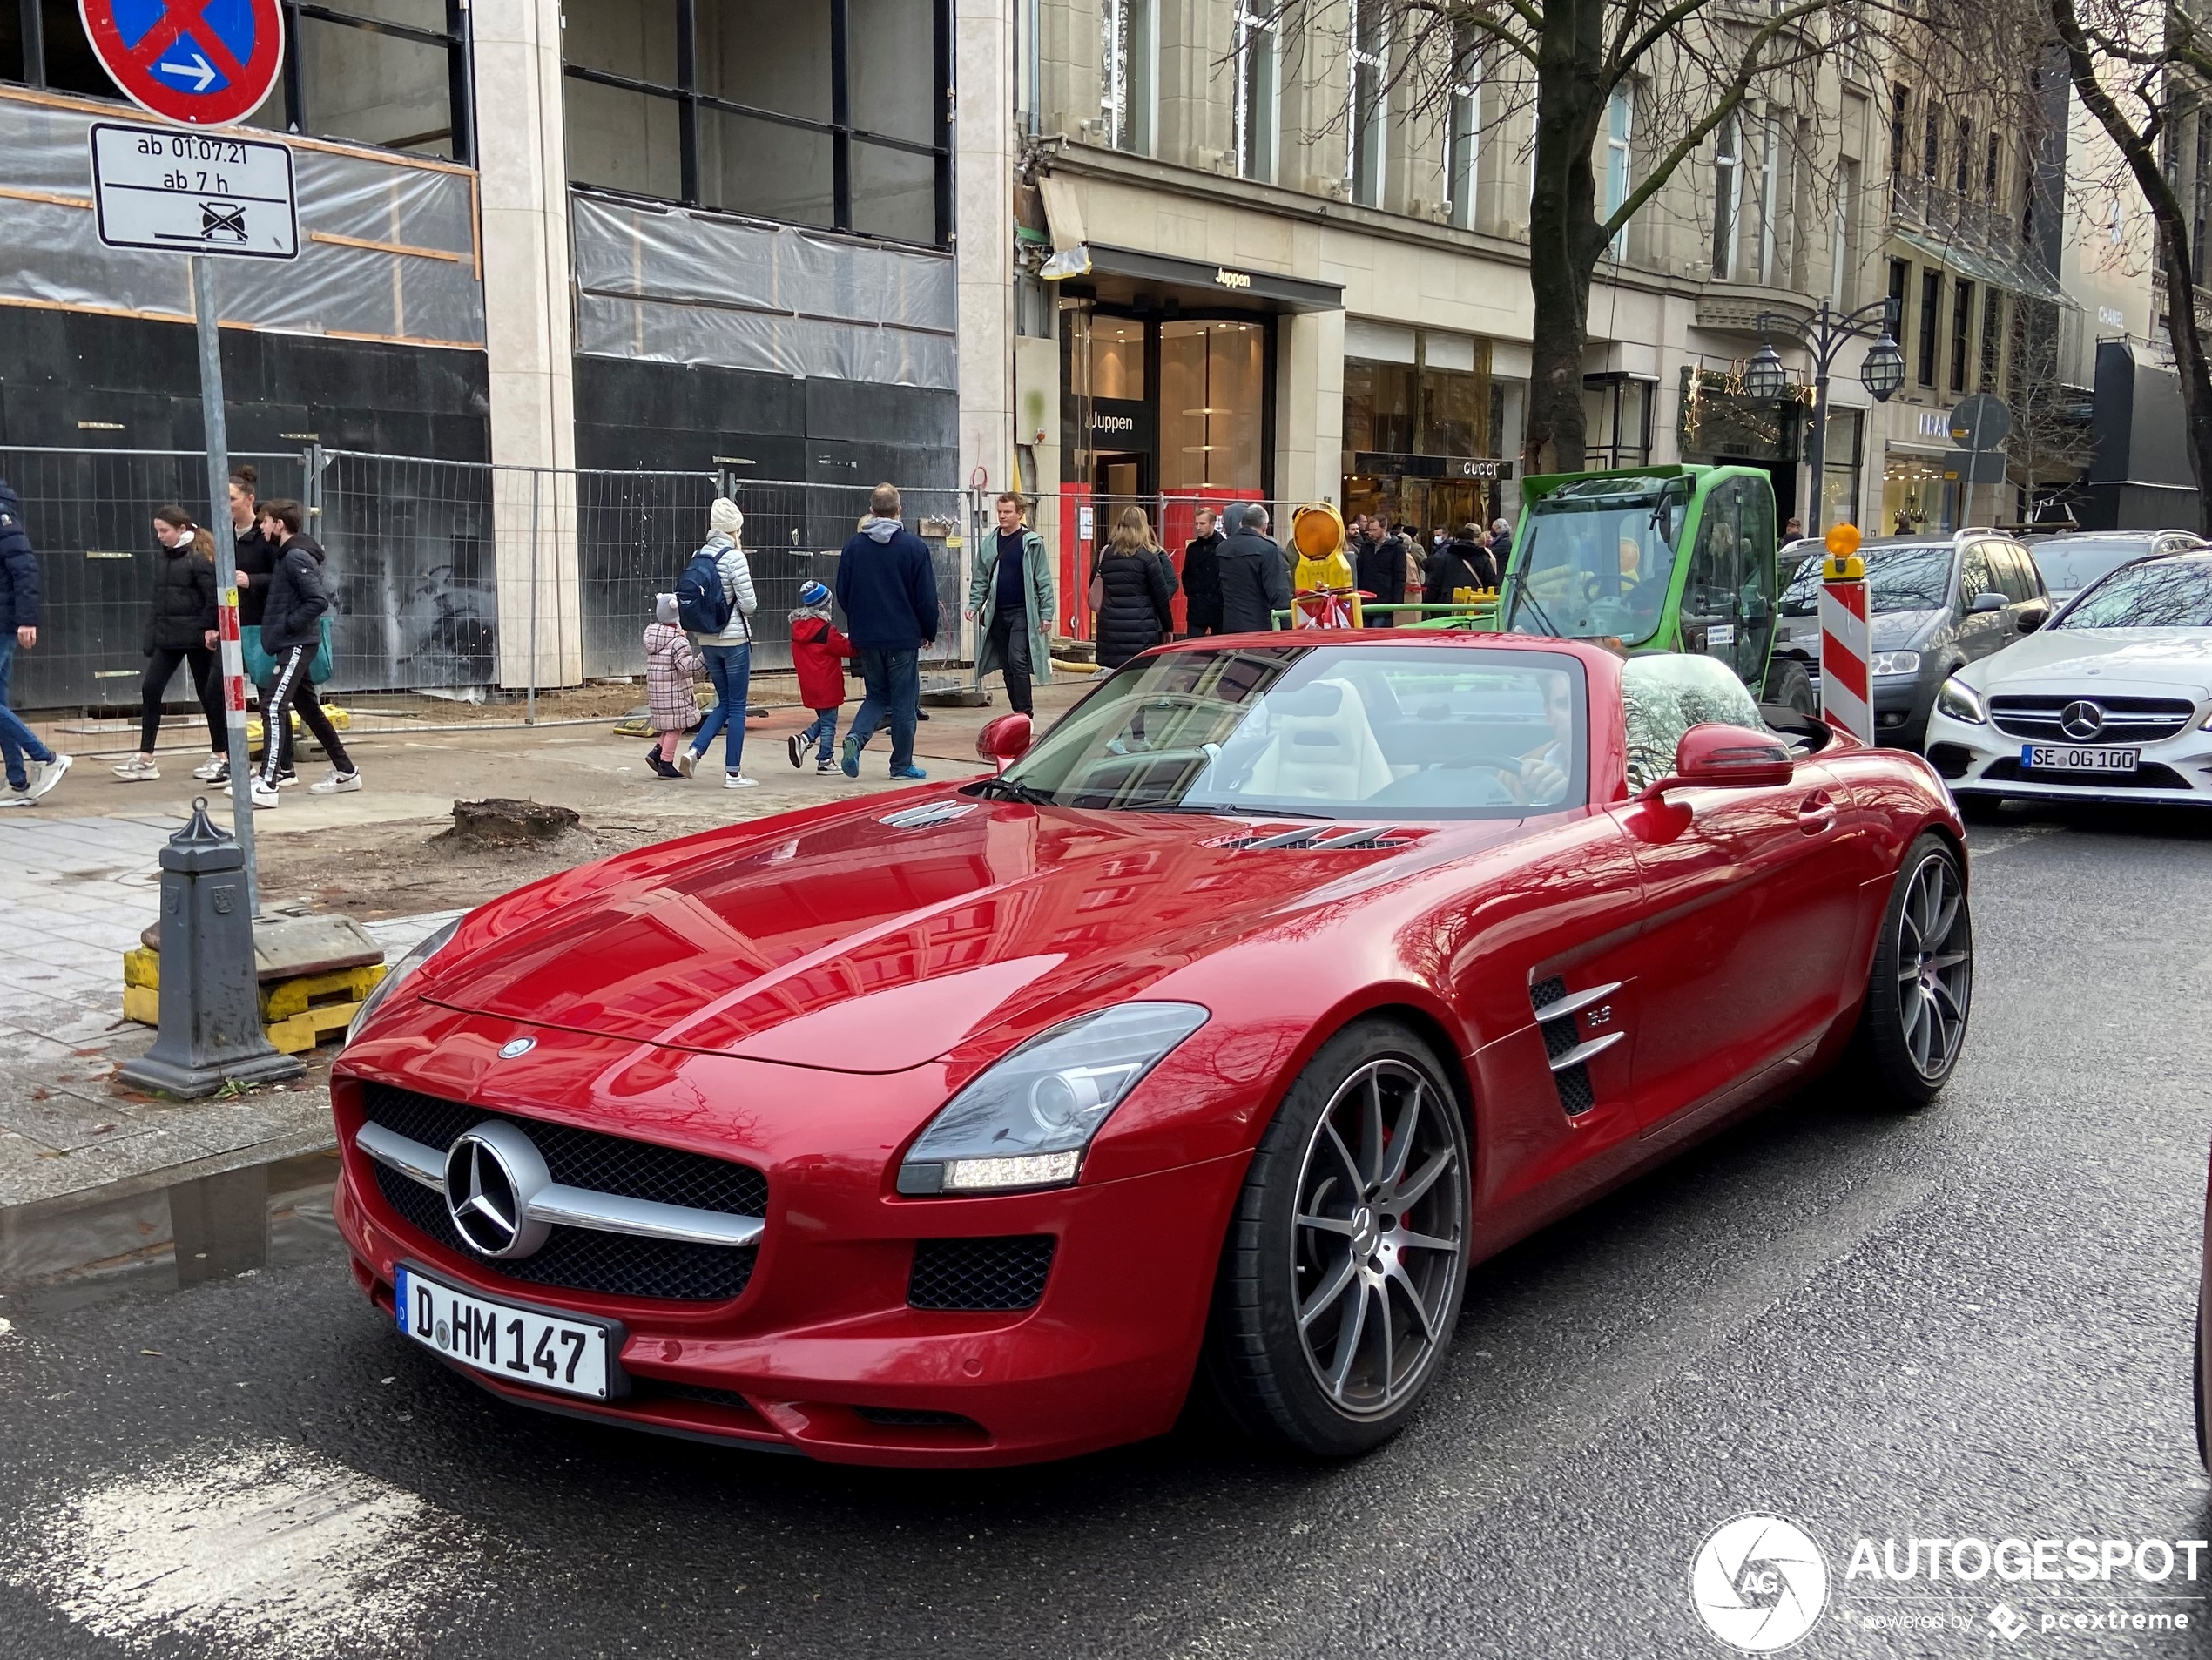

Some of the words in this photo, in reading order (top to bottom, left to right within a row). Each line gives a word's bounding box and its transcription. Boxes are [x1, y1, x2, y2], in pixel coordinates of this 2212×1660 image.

[138, 135, 163, 155] ab
[172, 137, 247, 165] 01.07.21
[164, 169, 188, 190] ab
[196, 171, 207, 191] 7
[216, 172, 229, 193] h
[1215, 267, 1251, 289] Juppen
[2098, 305, 2124, 329] CHANEL
[1091, 410, 1133, 434] Juppen
[1463, 462, 1497, 476] GUCCI
[2033, 749, 2056, 766] SE
[2068, 750, 2093, 767] OG
[2097, 752, 2134, 768] 100
[416, 1285, 434, 1339] D
[452, 1299, 496, 1365] HM
[506, 1318, 586, 1383] 147
